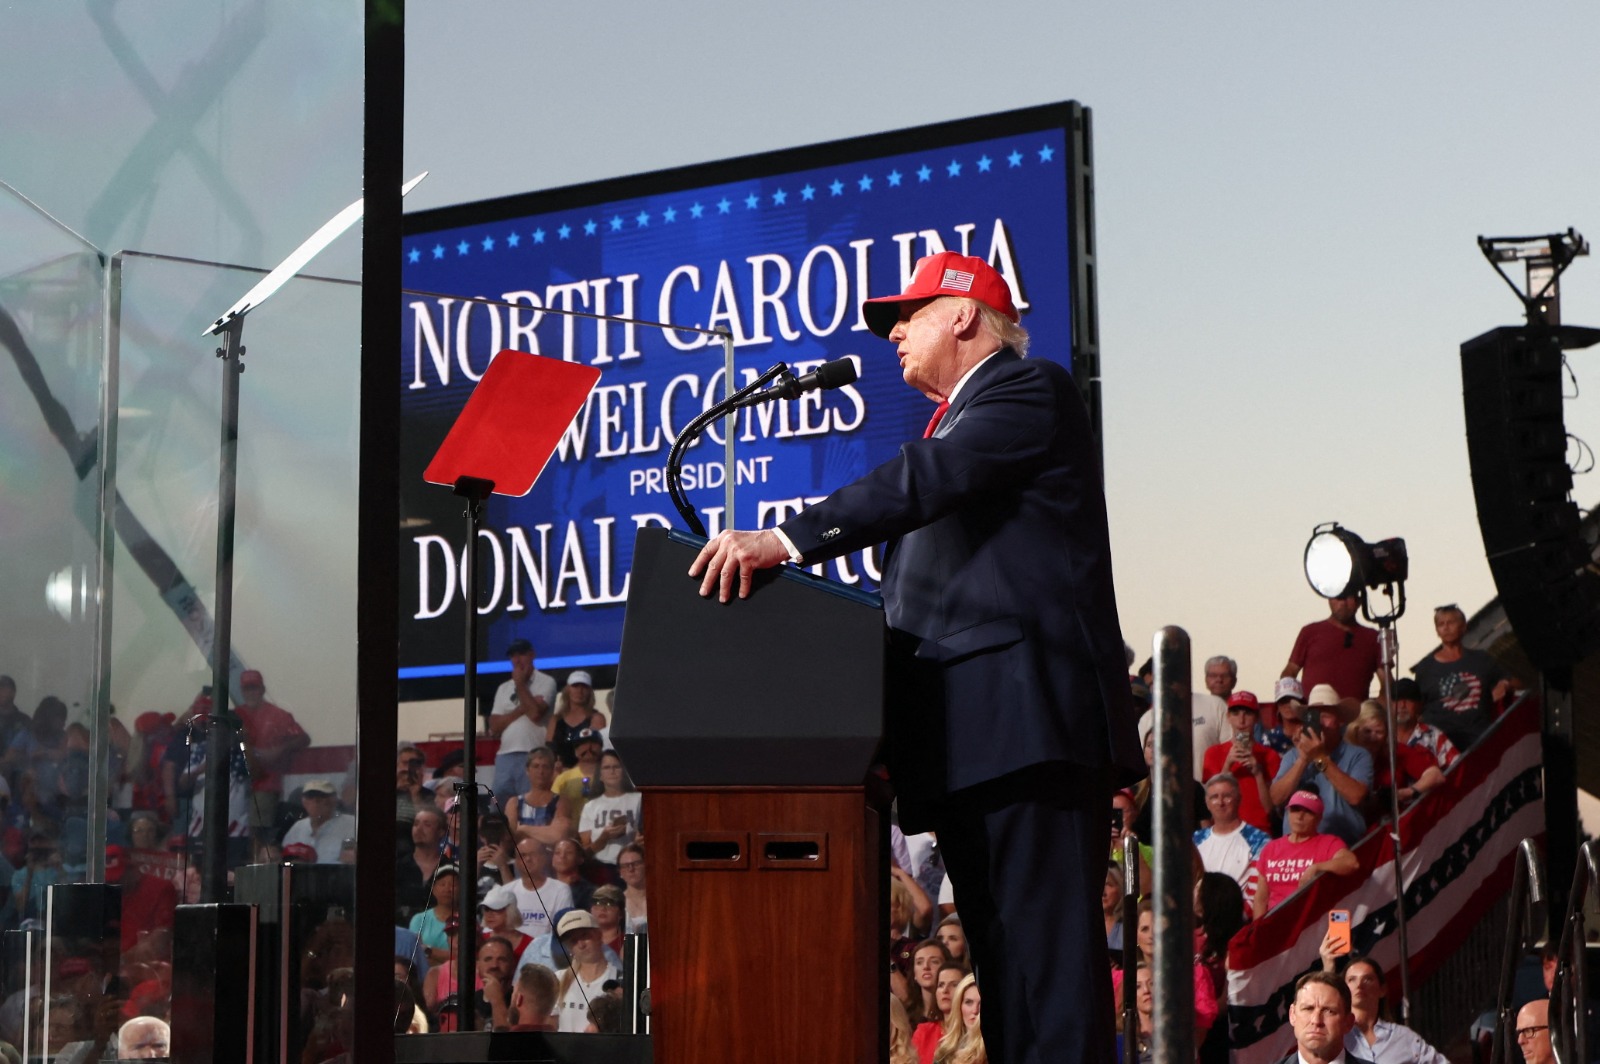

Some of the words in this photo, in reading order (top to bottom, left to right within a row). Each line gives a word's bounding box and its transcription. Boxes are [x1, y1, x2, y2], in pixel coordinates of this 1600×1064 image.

[408, 273, 641, 390] NORTH
[413, 512, 672, 620] DONAL
[1266, 858, 1314, 869] WOMEN
[1266, 872, 1304, 882] TRUM
[522, 912, 546, 921] UMP
